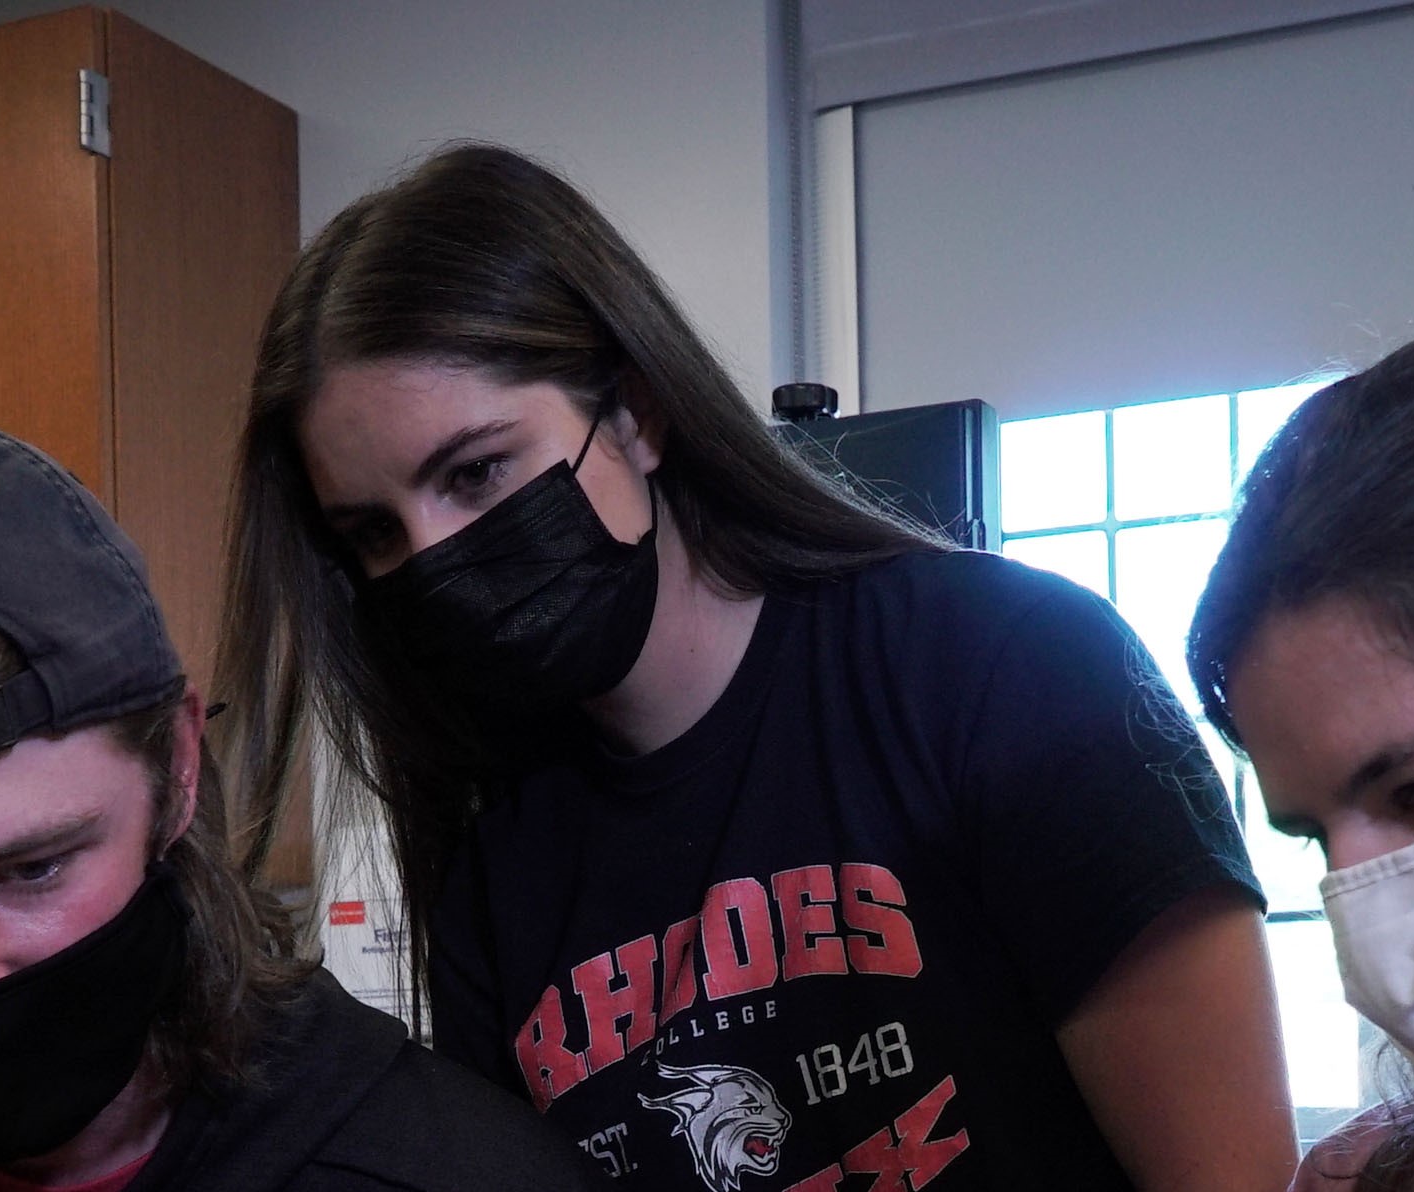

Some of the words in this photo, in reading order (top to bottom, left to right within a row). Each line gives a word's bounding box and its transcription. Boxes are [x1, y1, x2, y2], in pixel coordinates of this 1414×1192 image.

[515, 862, 924, 1114] RHODES
[640, 1000, 777, 1067] COLLEGE
[578, 1122, 638, 1178] ST.
[796, 1021, 914, 1106] 1848
